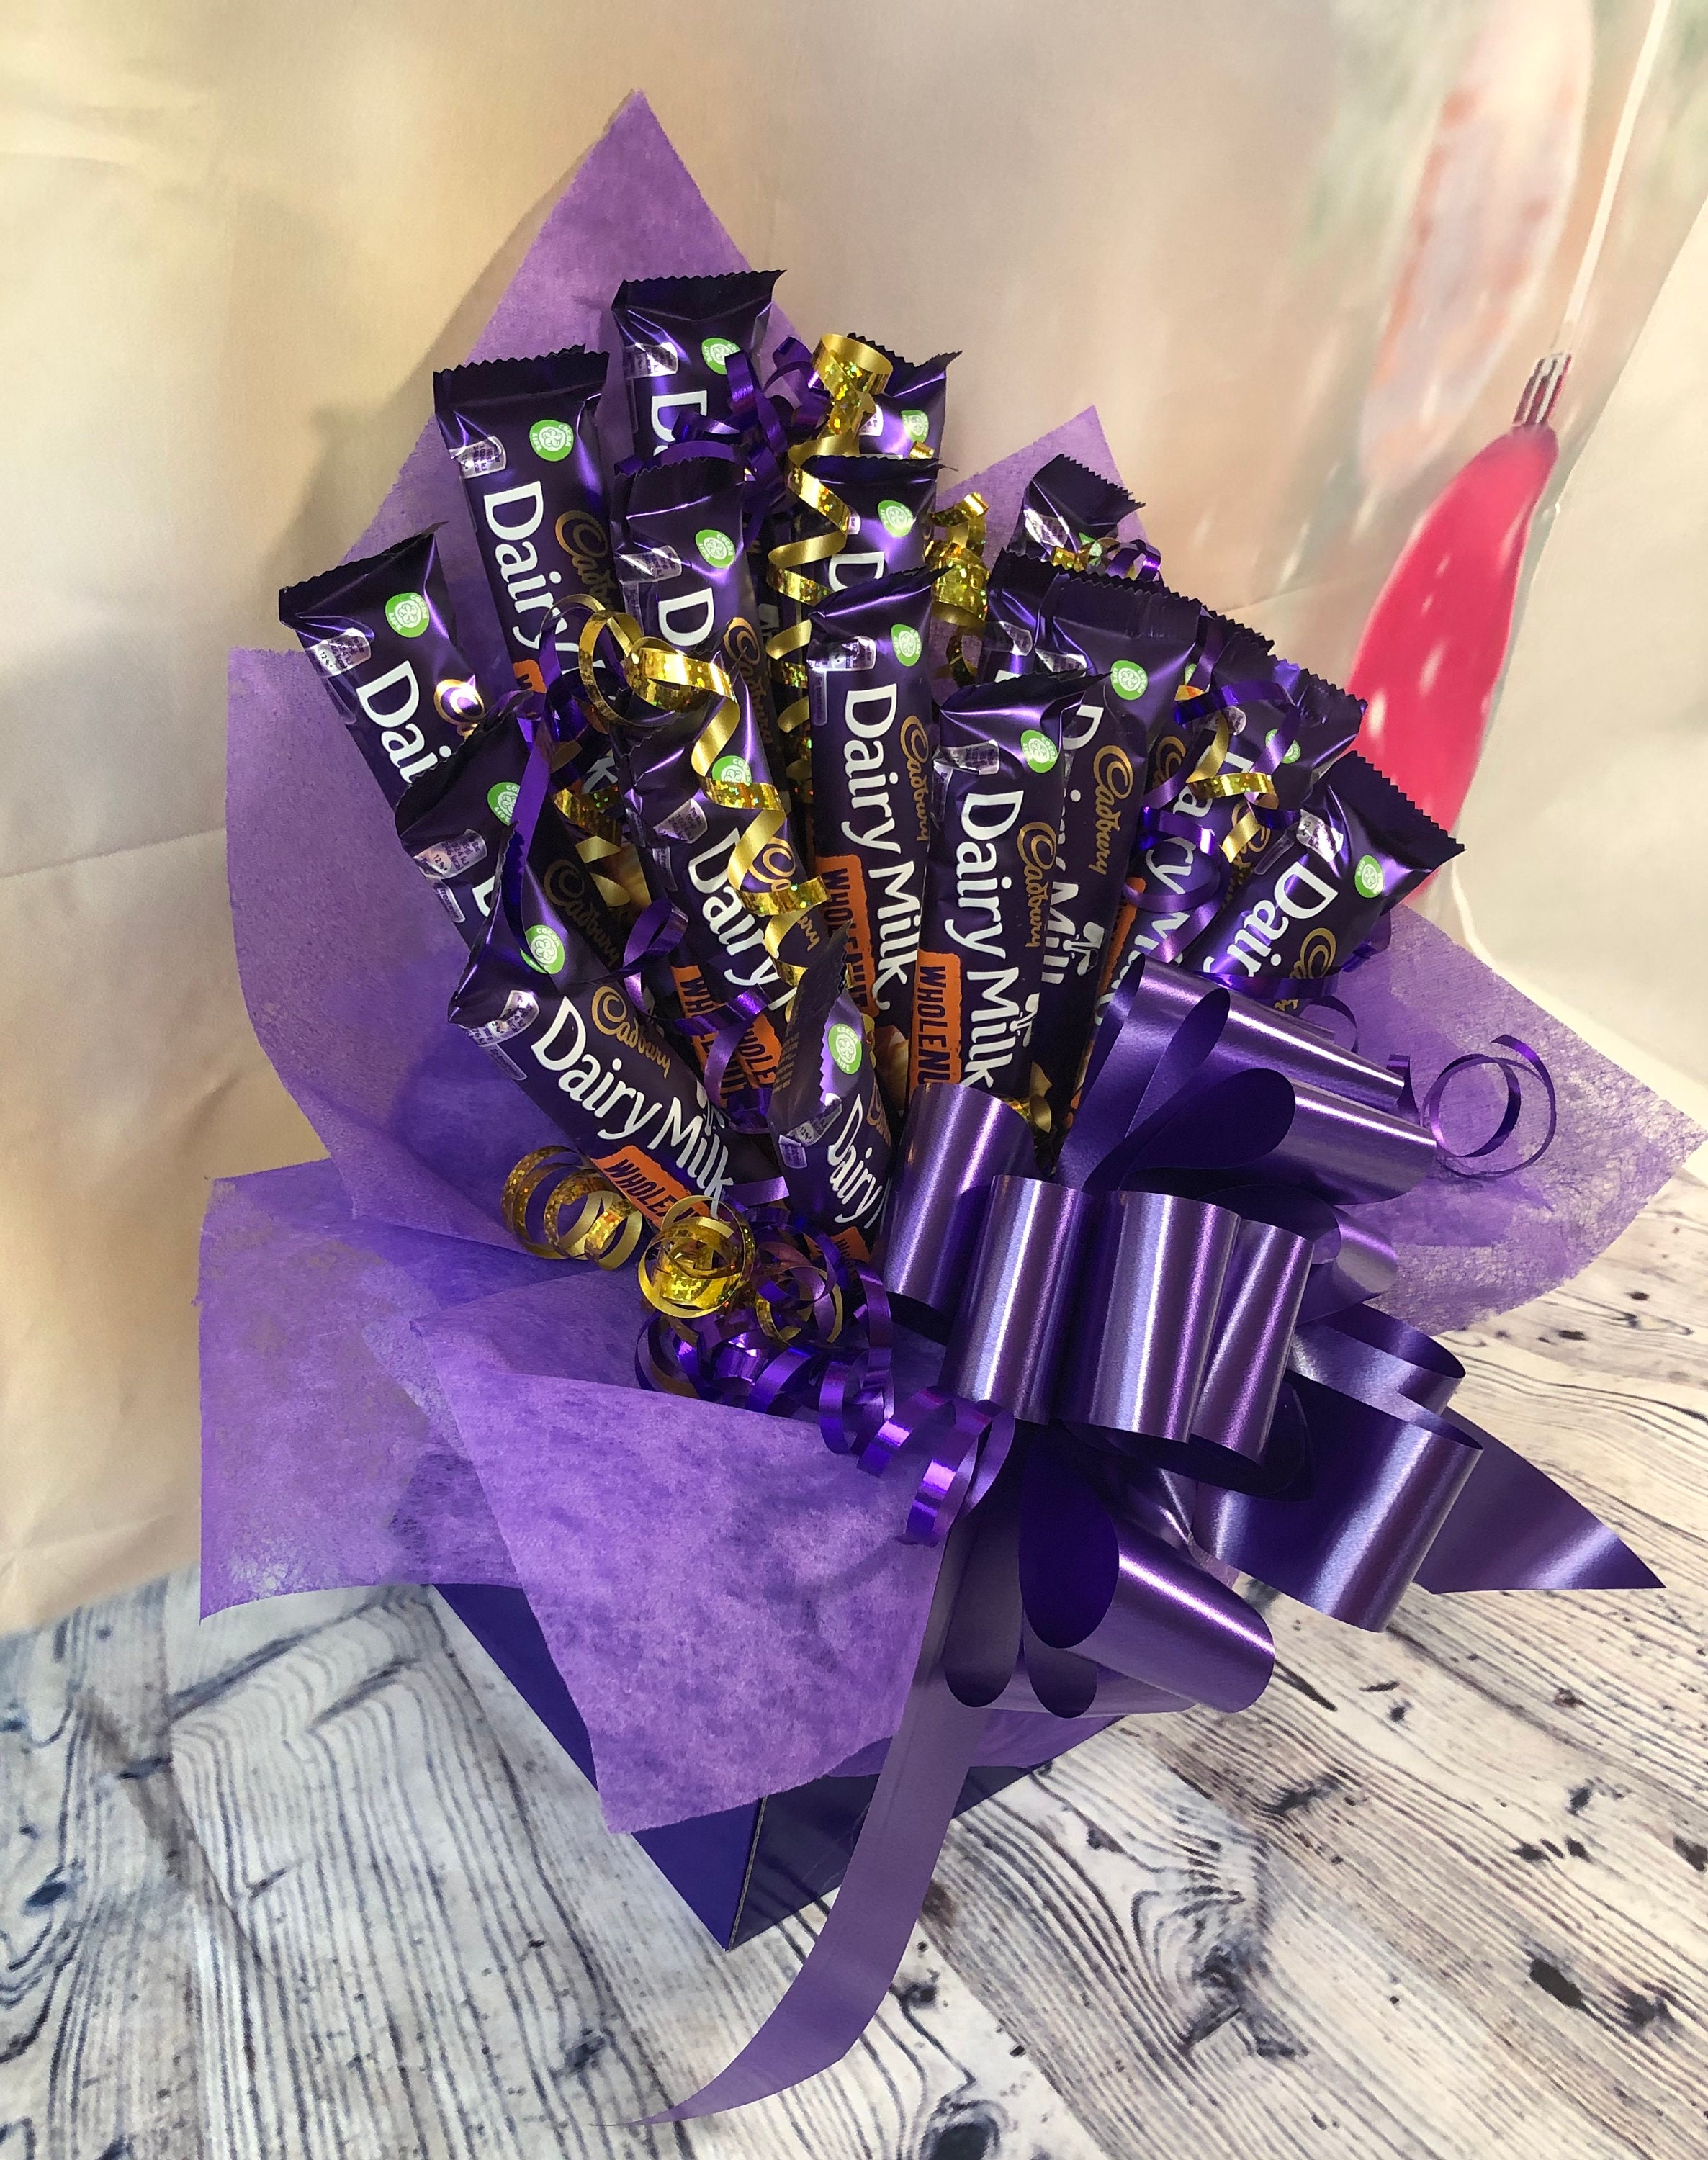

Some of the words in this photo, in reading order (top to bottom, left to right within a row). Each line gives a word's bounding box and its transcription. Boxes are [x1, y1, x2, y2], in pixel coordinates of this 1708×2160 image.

[531, 433, 541, 451] LIFE
[558, 424, 572, 447] COCOA
[697, 542, 710, 560] LIFE
[716, 534, 733, 556] COCOA
[387, 613, 402, 631] LIFE
[409, 595, 428, 620] COCOA
[841, 683, 902, 854] Dairy
[899, 715, 932, 842] Cadbury
[1089, 744, 1133, 876] Cadbury
[945, 790, 1024, 960] Dairy
[1017, 822, 1057, 948] Cadbury
[535, 927, 560, 948] COCOA
[867, 861, 921, 1011] Milk
[591, 985, 670, 1078] Cadbury
[835, 1026, 858, 1045] COCOA
[835, 1056, 849, 1071] LIFE
[962, 966, 1020, 1088] Milk
[531, 996, 662, 1140] Dairy
[647, 1097, 734, 1220] Milk
[827, 1094, 883, 1223] Dairy
